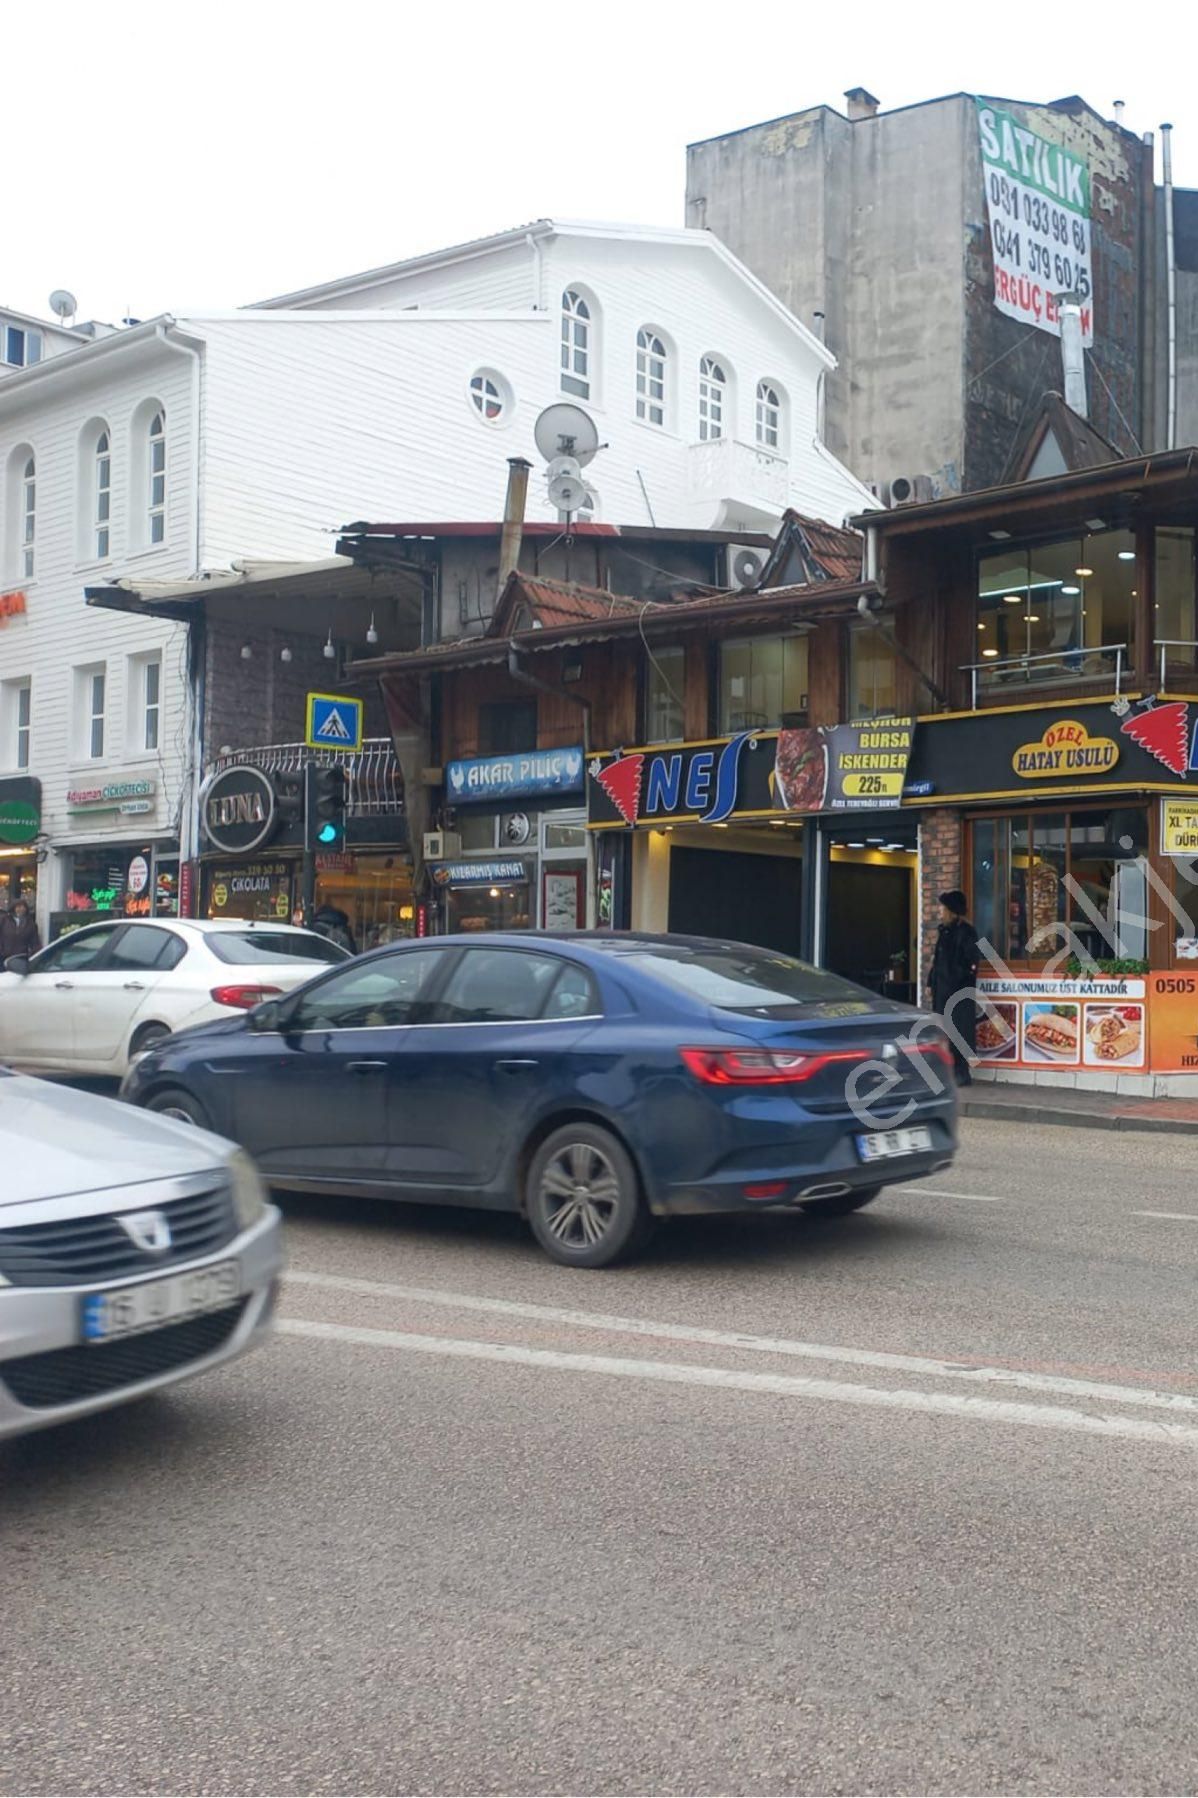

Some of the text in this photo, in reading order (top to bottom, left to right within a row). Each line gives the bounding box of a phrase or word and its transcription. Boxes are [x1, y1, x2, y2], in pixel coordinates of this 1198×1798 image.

[979, 109, 1084, 208] SATILIK
[1024, 194, 1050, 235] 033
[1052, 209, 1068, 246] 98
[1055, 254, 1072, 289] 60
[860, 731, 910, 749] BURSA
[468, 754, 562, 788] AKAR PİLİÇ
[838, 752, 908, 770] İSKENDER
[1017, 741, 1114, 772] HATAY USULÜ
[646, 729, 764, 823] NES
[209, 793, 266, 826] LUNA
[1169, 816, 1181, 829] XL
[450, 862, 493, 881] KIZARMIŞ
[1001, 982, 1058, 994] SALONUMUZ
[1155, 978, 1195, 993] 0505
